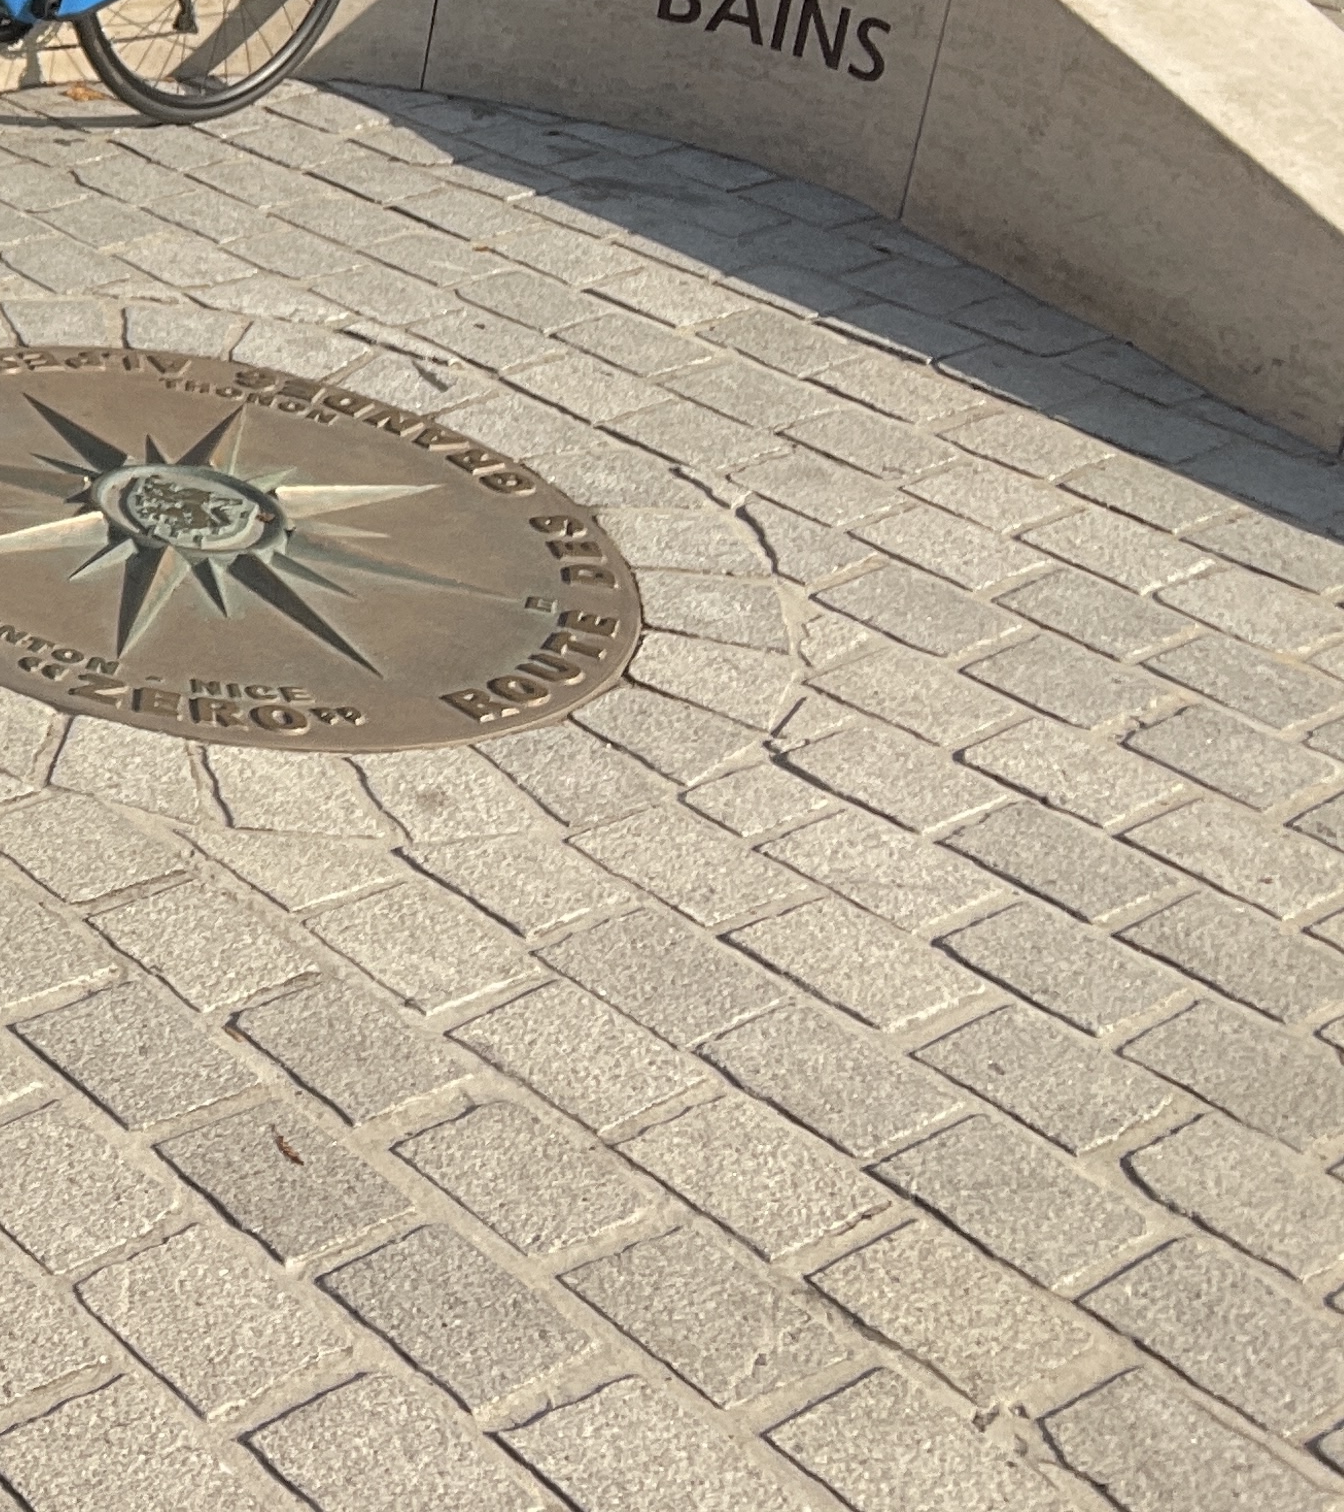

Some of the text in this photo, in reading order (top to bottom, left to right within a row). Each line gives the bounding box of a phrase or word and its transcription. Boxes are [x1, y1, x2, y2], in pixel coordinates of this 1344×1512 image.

[164, 376, 338, 426] THONON
[234, 367, 537, 497] GRANDES
[528, 514, 620, 589] DES
[190, 678, 316, 704] NICE
[439, 609, 620, 724] ROUTE
